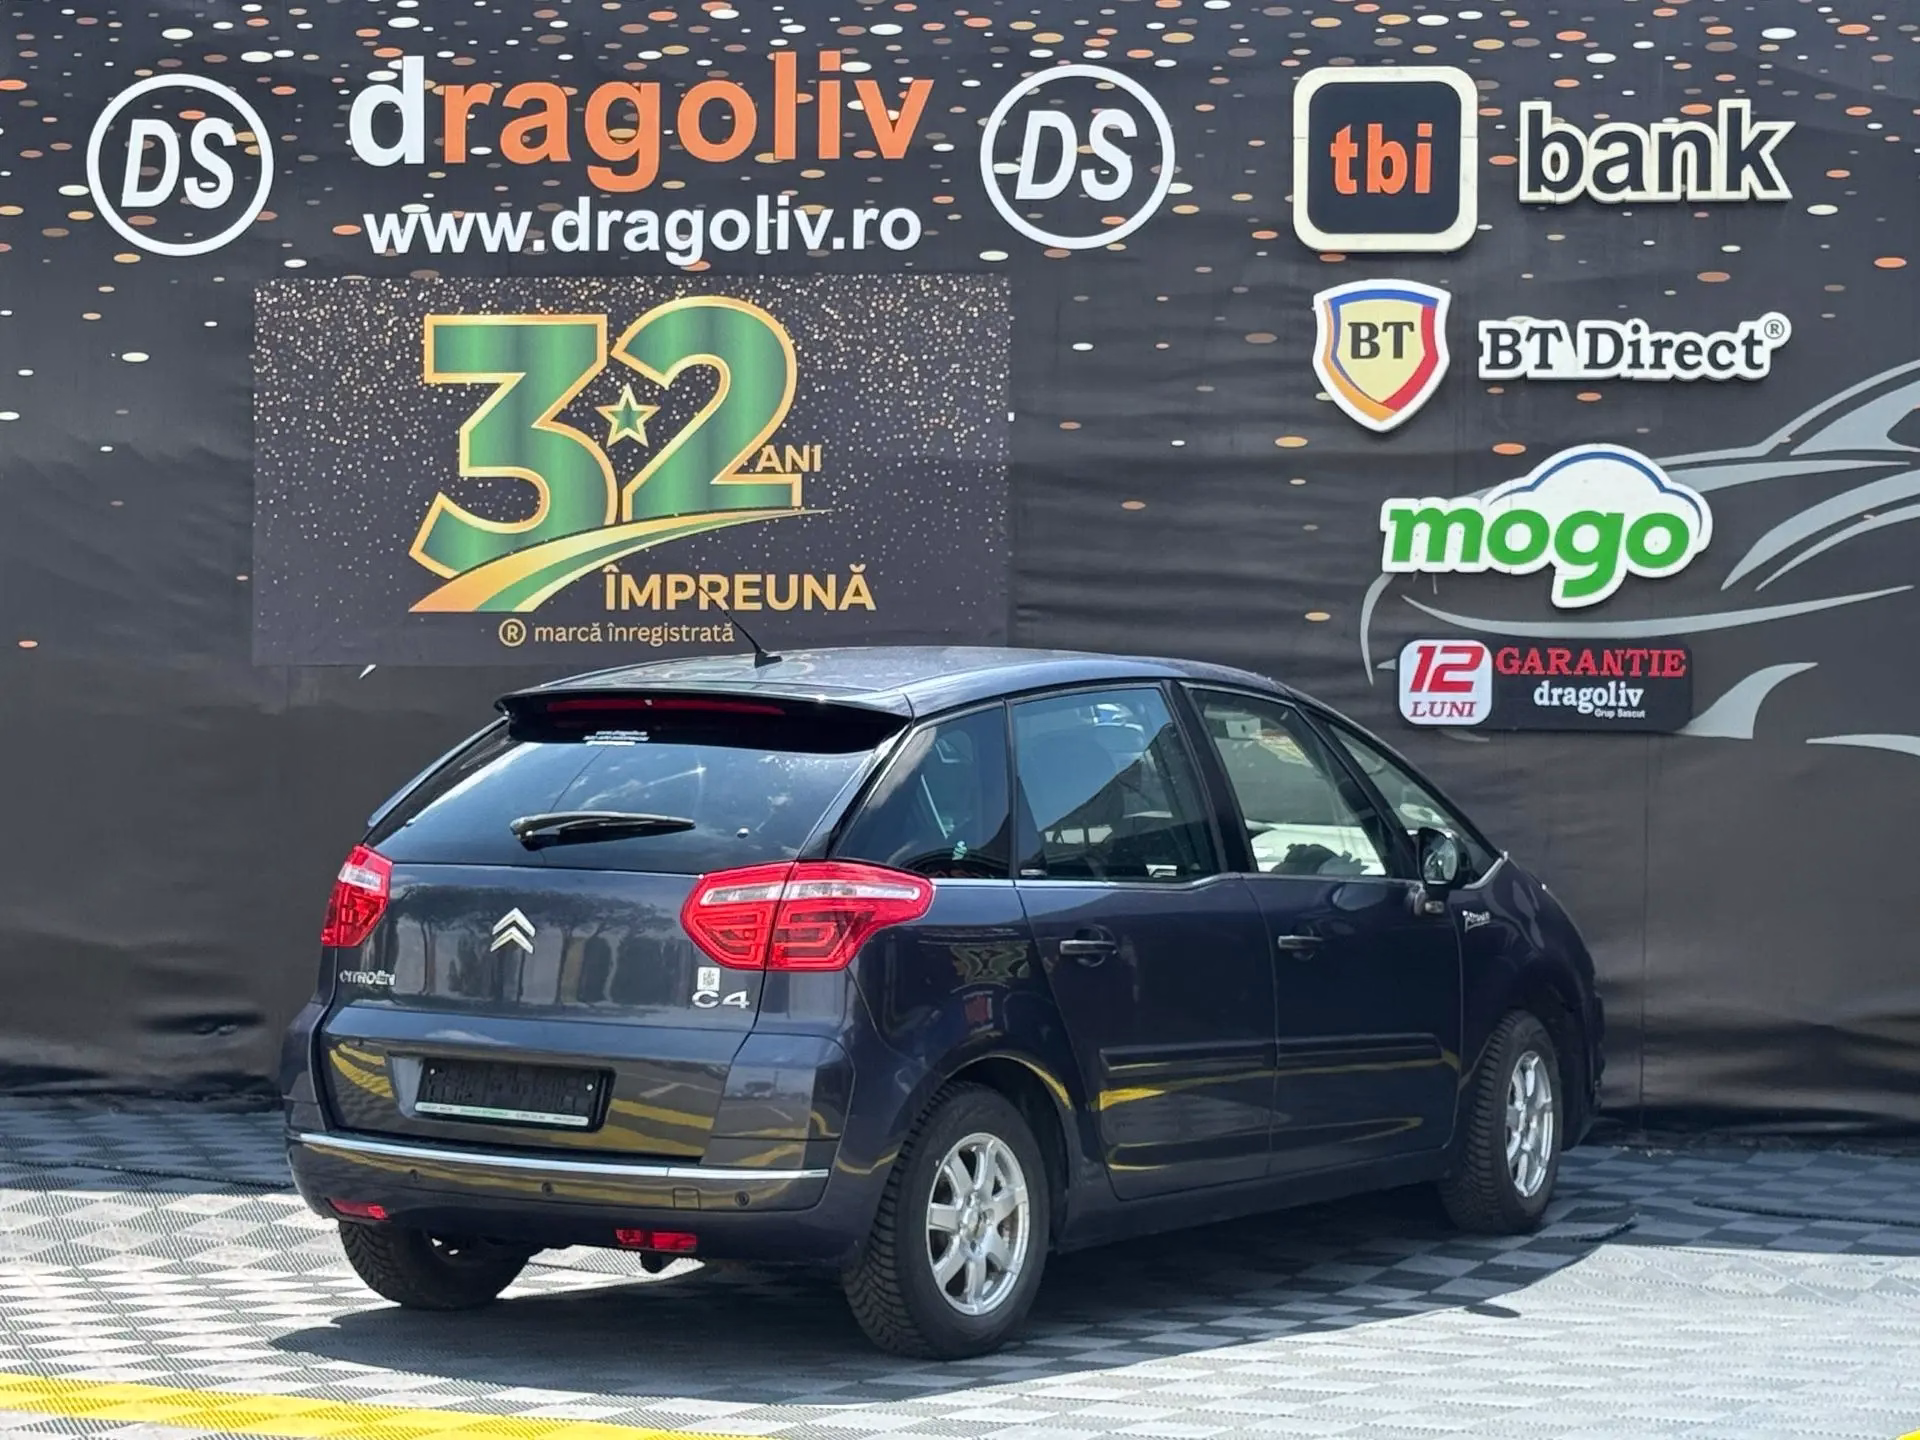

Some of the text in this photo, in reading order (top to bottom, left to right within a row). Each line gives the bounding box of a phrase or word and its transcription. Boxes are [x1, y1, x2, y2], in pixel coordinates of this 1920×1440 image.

[347, 53, 934, 193] dragoliv
[119, 116, 238, 210] DS
[1014, 107, 1139, 202] DS
[1330, 122, 1434, 195] tbi
[1526, 102, 1788, 197] bank
[362, 194, 922, 267] www.dragoliv.ro
[1349, 320, 1415, 361] BT
[1484, 325, 1564, 371] BT
[408, 295, 802, 580] 32
[754, 445, 822, 473] ANI
[1388, 506, 1690, 599] mogo
[602, 563, 877, 612] ÎMPREUNĂ
[534, 622, 602, 643] marcă
[607, 621, 735, 647] înregistrată
[1408, 645, 1485, 693] 12
[1496, 646, 1687, 678] GARANTIE
[1409, 700, 1477, 718] LUNI
[1533, 679, 1644, 714] dragoliv
[691, 990, 750, 1009] C4
